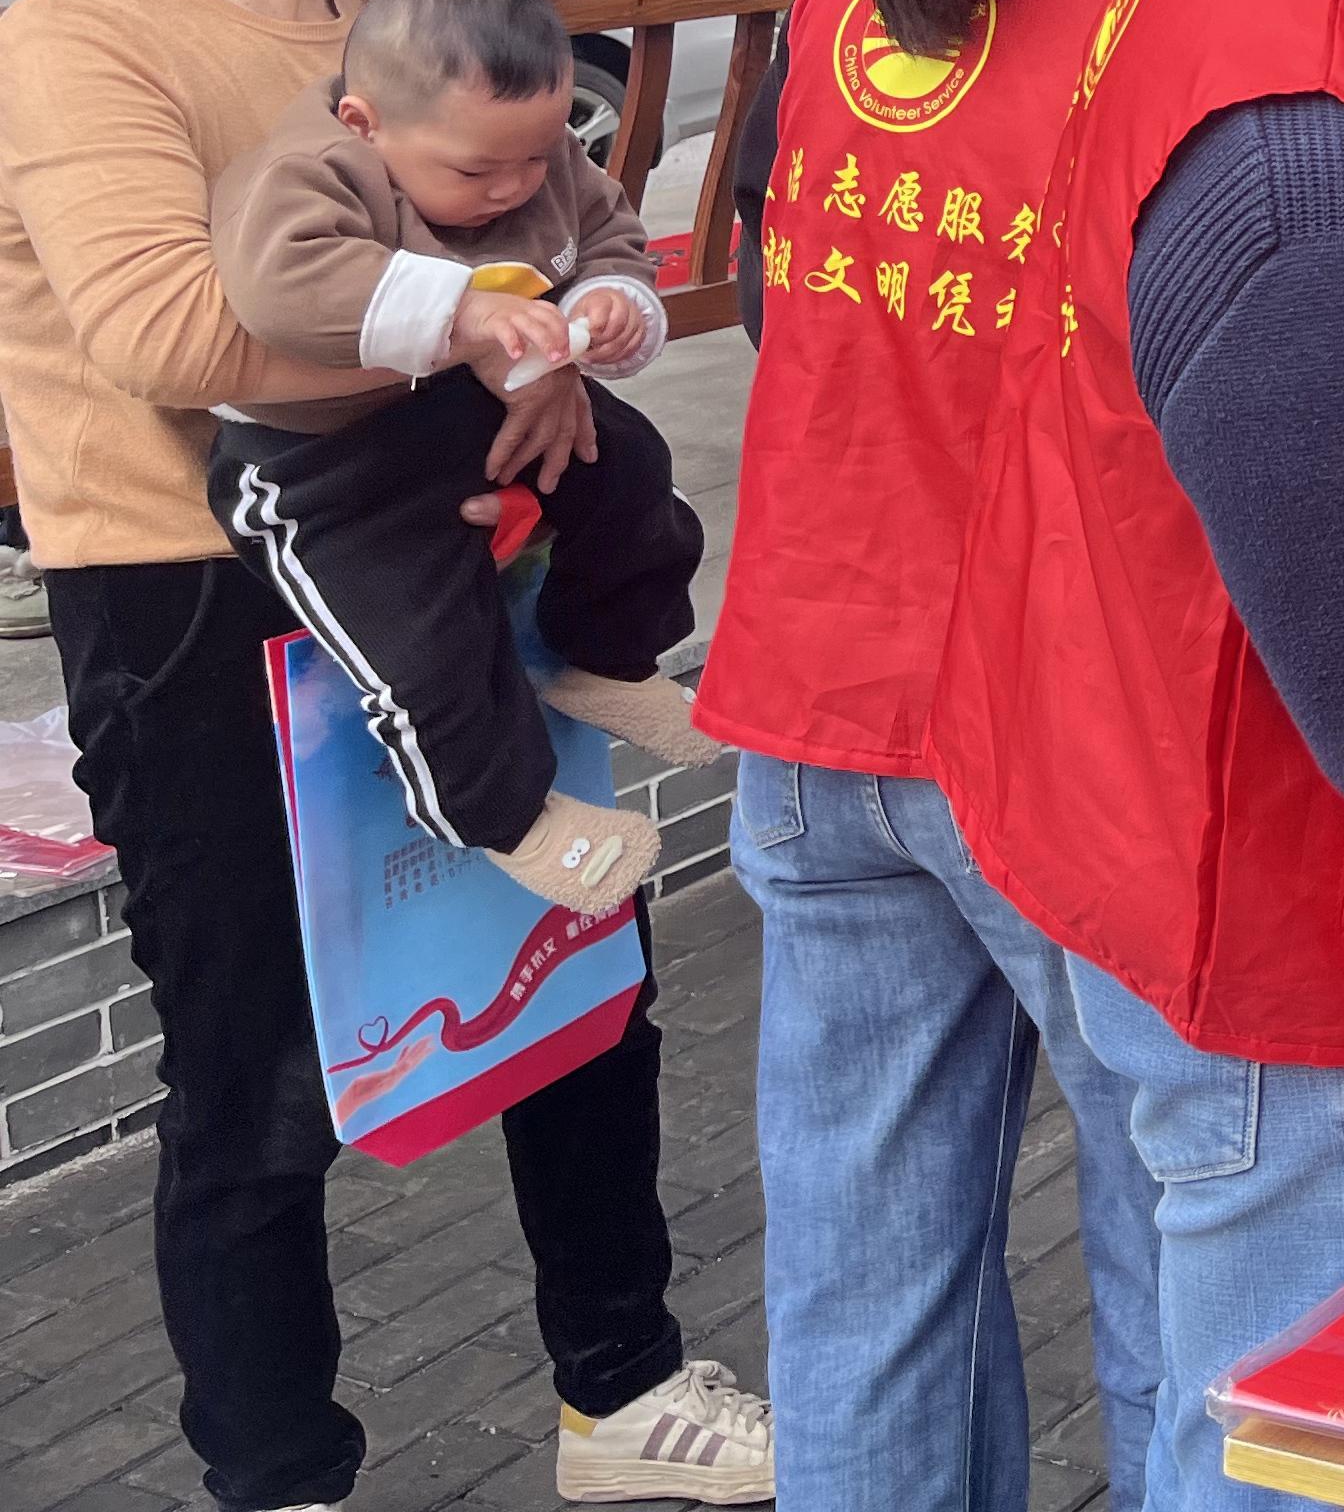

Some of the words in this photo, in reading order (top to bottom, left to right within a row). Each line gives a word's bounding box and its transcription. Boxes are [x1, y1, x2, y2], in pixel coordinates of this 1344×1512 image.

[844, 44, 861, 92] China
[858, 88, 921, 121] Volunteer
[922, 68, 965, 115] Service
